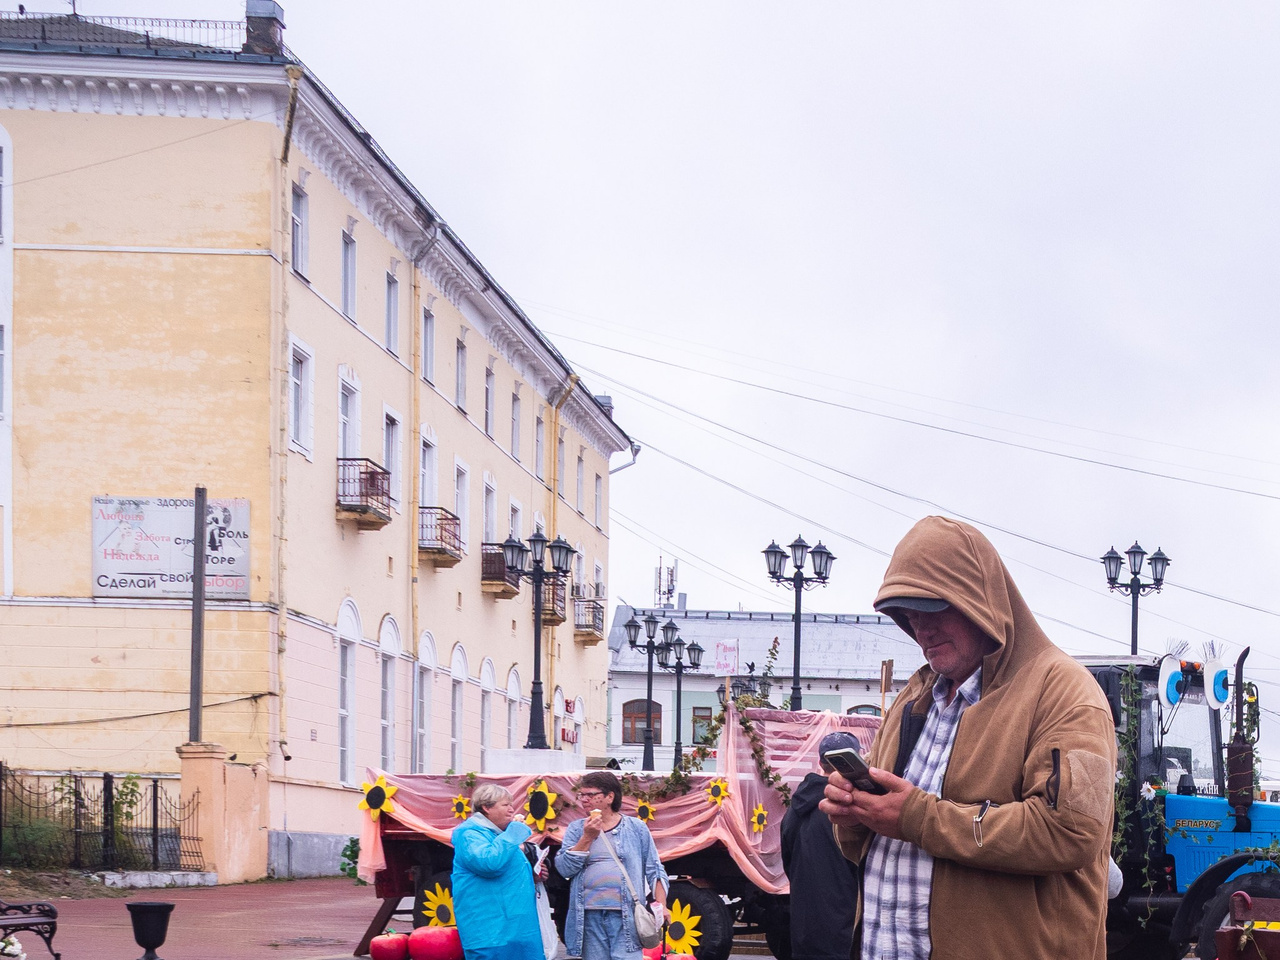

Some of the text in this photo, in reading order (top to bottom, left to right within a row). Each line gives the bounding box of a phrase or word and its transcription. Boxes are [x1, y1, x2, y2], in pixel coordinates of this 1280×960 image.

[157, 498, 195, 509] здоров
[95, 508, 145, 521] Любовь
[134, 531, 171, 542] Забота
[218, 527, 249, 539] Боль
[174, 537, 195, 546] Стр
[103, 548, 160, 561] Надежда
[97, 571, 245, 591] Сделай свой ыбор
[1175, 819, 1216, 829] БЕЛАРУС
